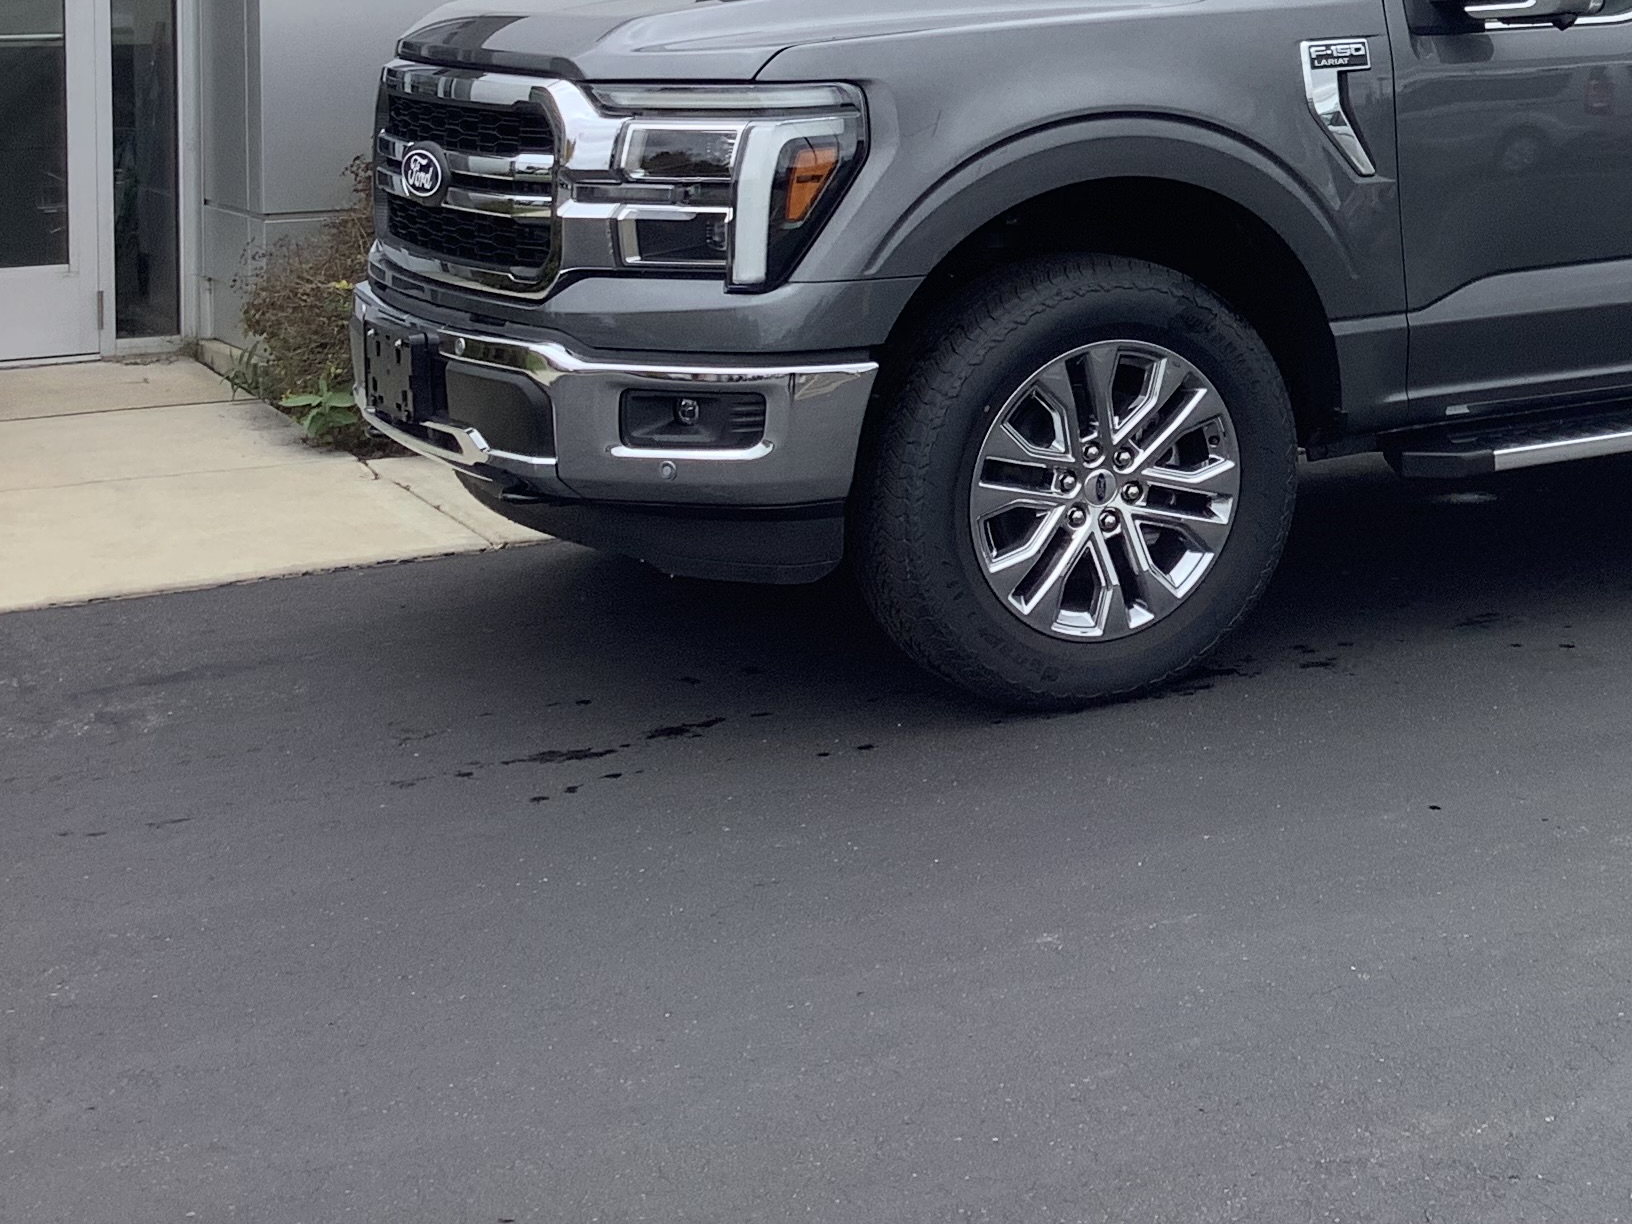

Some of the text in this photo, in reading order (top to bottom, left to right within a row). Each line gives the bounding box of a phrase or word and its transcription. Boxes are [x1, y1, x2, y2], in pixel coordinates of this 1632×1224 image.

[1310, 43, 1366, 58] F-150
[1314, 57, 1350, 66] LARIAT
[408, 155, 434, 190] Ford
